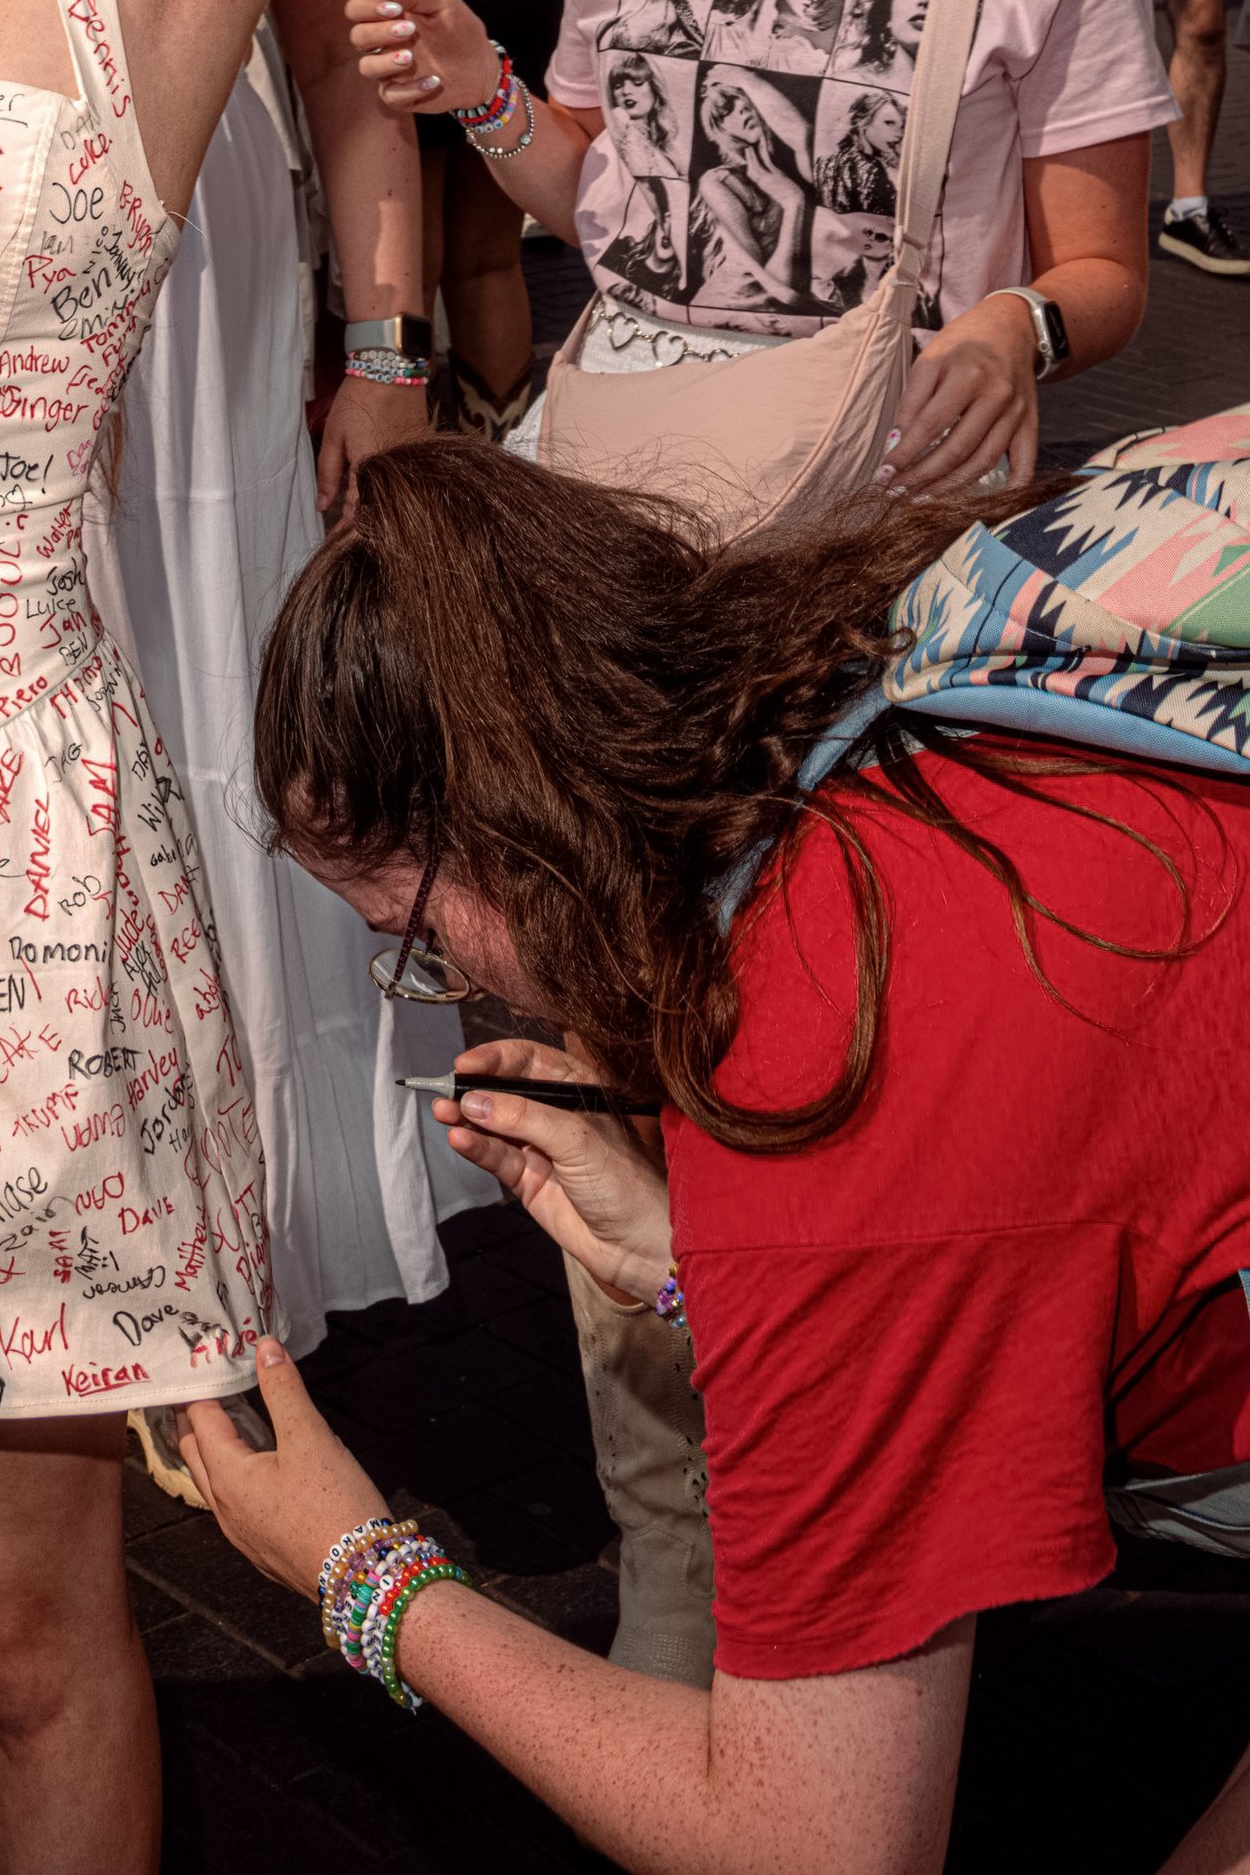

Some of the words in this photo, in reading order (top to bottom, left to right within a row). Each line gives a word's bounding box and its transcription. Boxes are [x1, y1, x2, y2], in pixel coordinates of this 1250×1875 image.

[49, 182, 104, 225] Joe
[51, 266, 113, 324] Ben
[23, 792, 51, 922] DANIEL
[67, 1046, 145, 1080] ROBERT
[126, 1047, 179, 1112] Harvey
[75, 1171, 127, 1216] NEO
[112, 1304, 179, 1347] Dave
